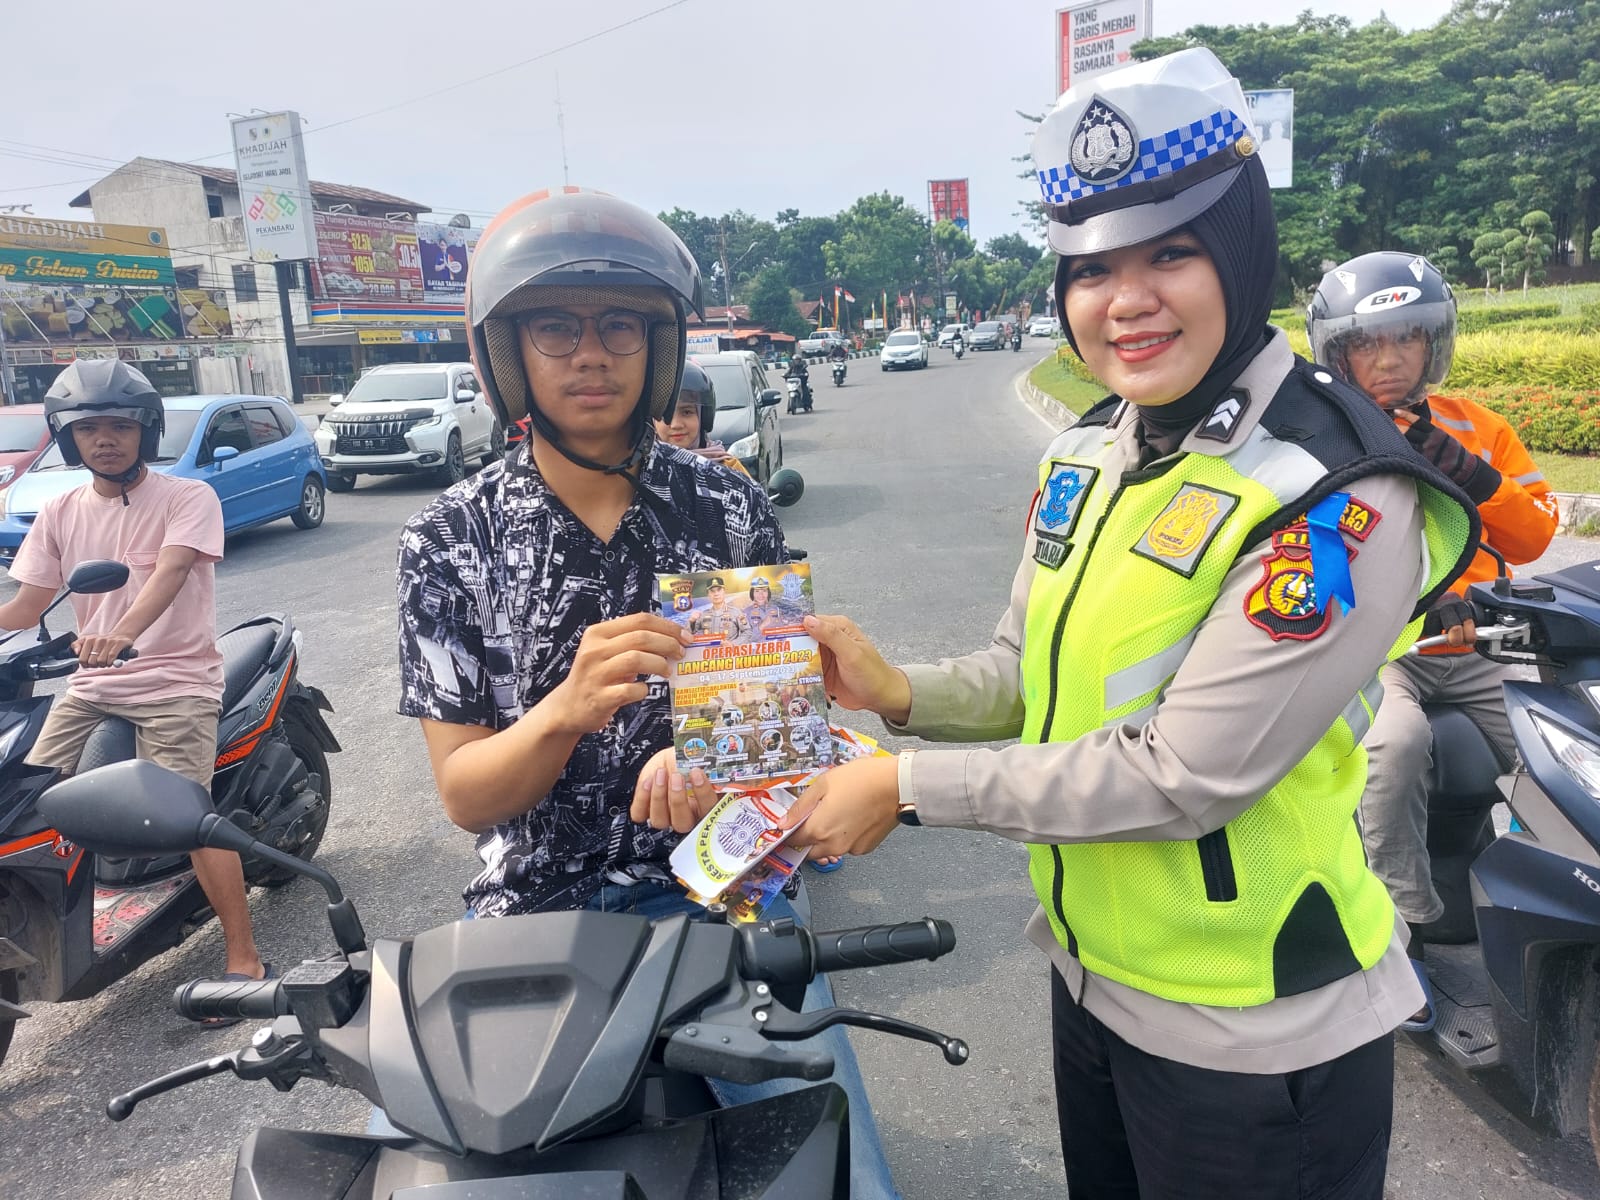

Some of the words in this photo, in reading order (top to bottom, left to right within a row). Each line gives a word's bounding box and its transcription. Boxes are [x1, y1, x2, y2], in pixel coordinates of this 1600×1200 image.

[1074, 9, 1097, 26] YANG
[1074, 23, 1100, 40] GARIS
[1102, 14, 1136, 34] MERAH
[1074, 38, 1114, 59] RASANYA
[1074, 53, 1114, 74] SAMAAA!
[240, 141, 287, 155] KHADIJAH
[256, 224, 295, 234] PEKANBARU
[95, 259, 159, 280] Durian
[1370, 292, 1408, 306] GM
[703, 642, 752, 659] OPERASI
[755, 640, 791, 655] ZEBRA
[677, 659, 735, 676] LANCANG
[735, 654, 782, 669] KUNING
[783, 650, 813, 664] 2023
[675, 714, 688, 731] 7
